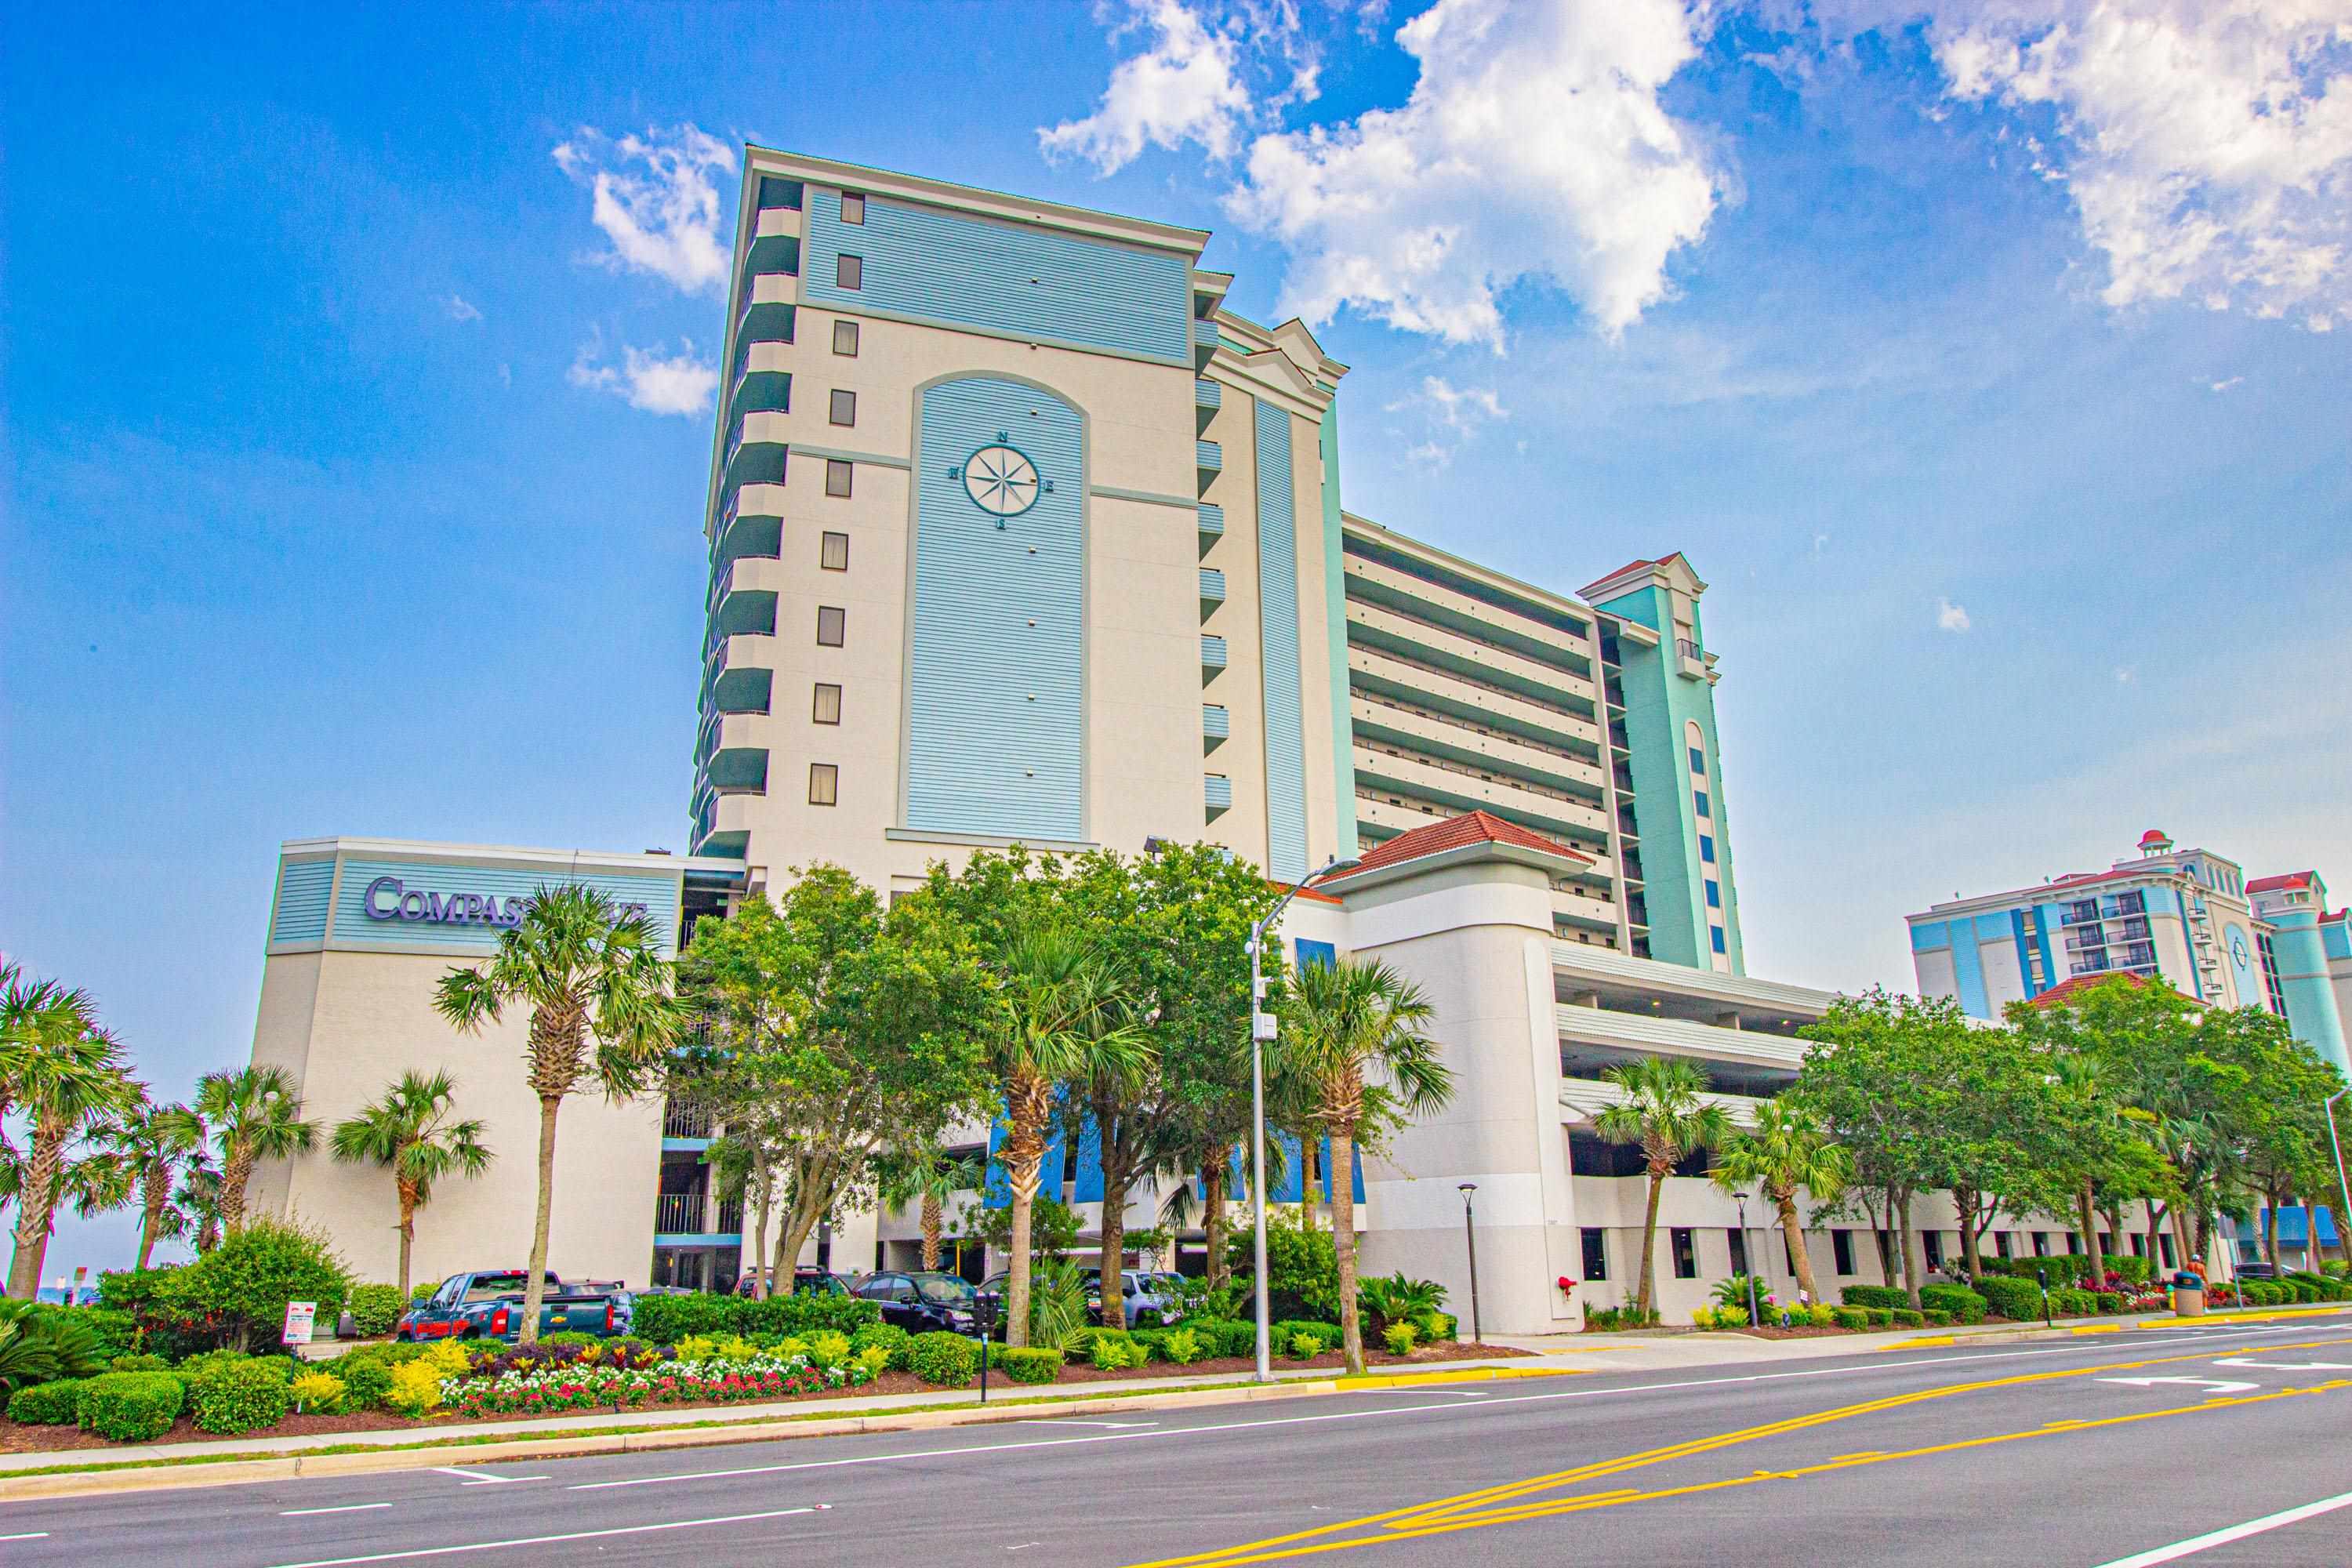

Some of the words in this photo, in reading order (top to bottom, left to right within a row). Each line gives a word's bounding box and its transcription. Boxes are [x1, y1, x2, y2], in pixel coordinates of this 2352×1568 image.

[997, 430, 1008, 442] N
[948, 466, 960, 479] W
[1045, 480, 1054, 492] E
[996, 518, 1006, 530] S
